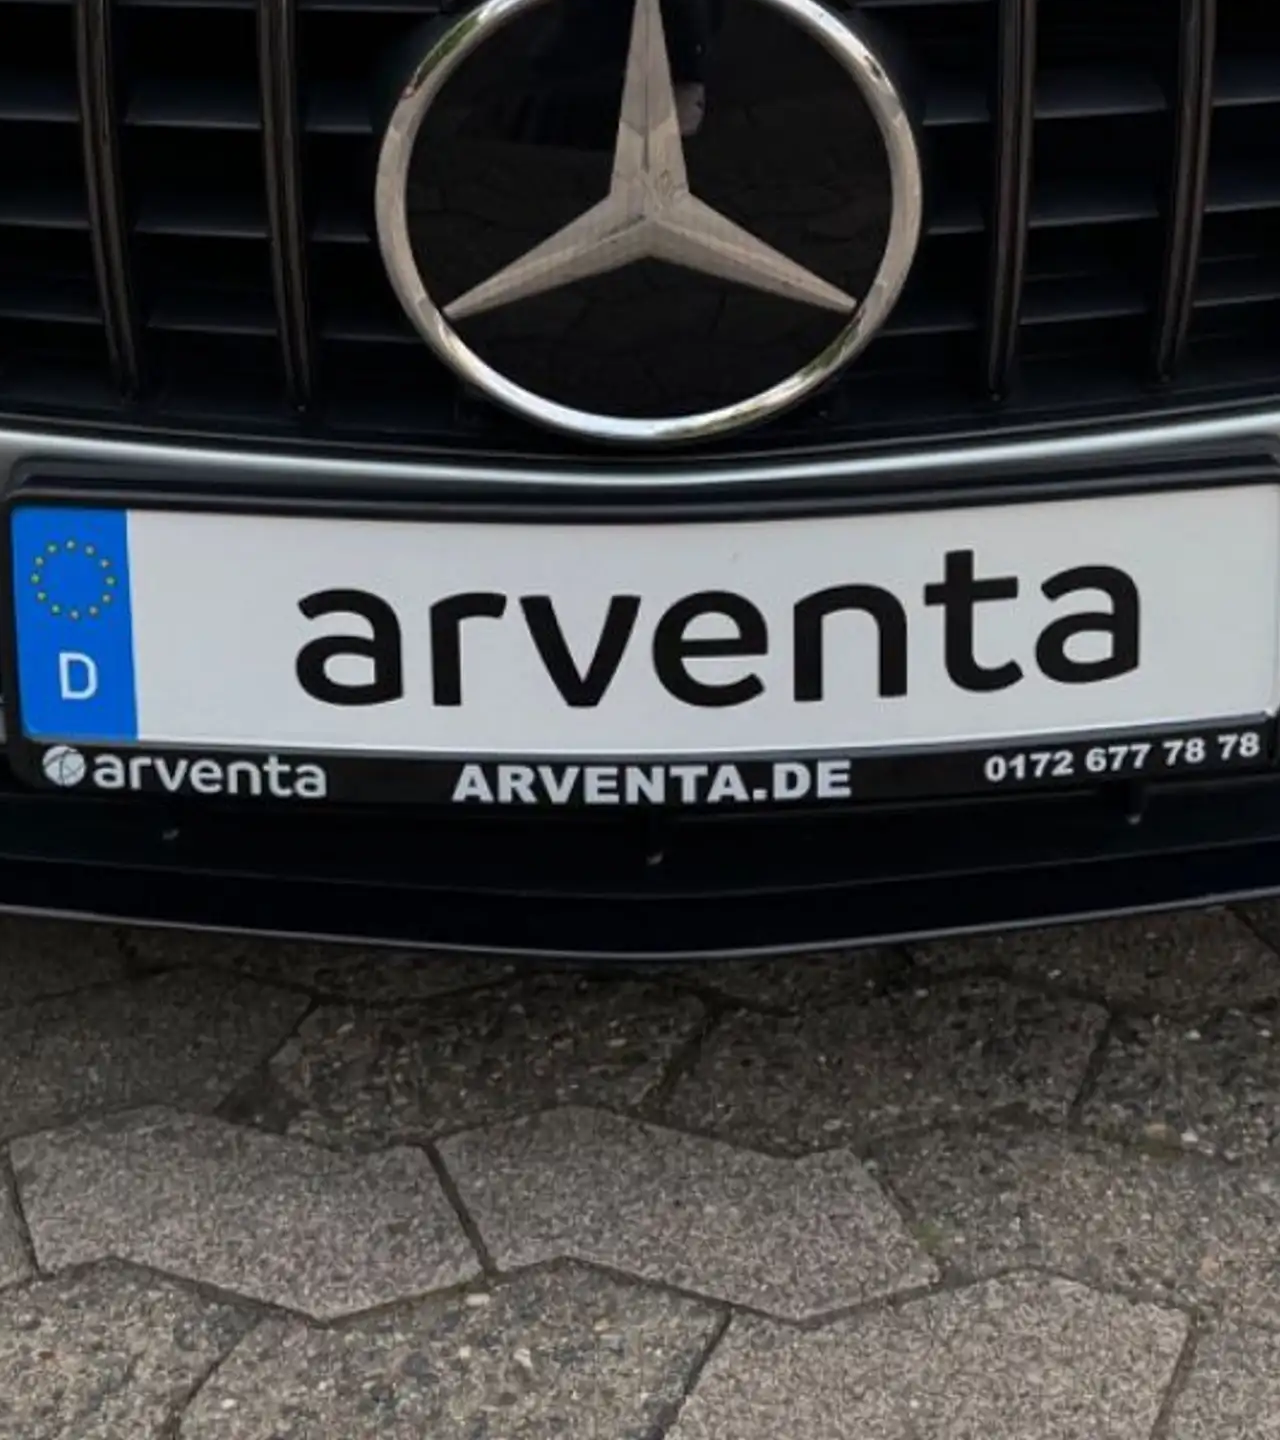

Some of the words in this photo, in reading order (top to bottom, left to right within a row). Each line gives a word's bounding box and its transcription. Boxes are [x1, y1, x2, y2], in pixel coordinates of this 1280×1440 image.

[295, 549, 1141, 709] arventa
[58, 651, 98, 700] D
[92, 753, 327, 798] arventa
[452, 760, 852, 803] ARVENTA.DE
[984, 750, 1074, 782] 0172
[1085, 743, 1152, 772] 677
[1163, 738, 1206, 766] 78
[1218, 732, 1261, 759] 78
